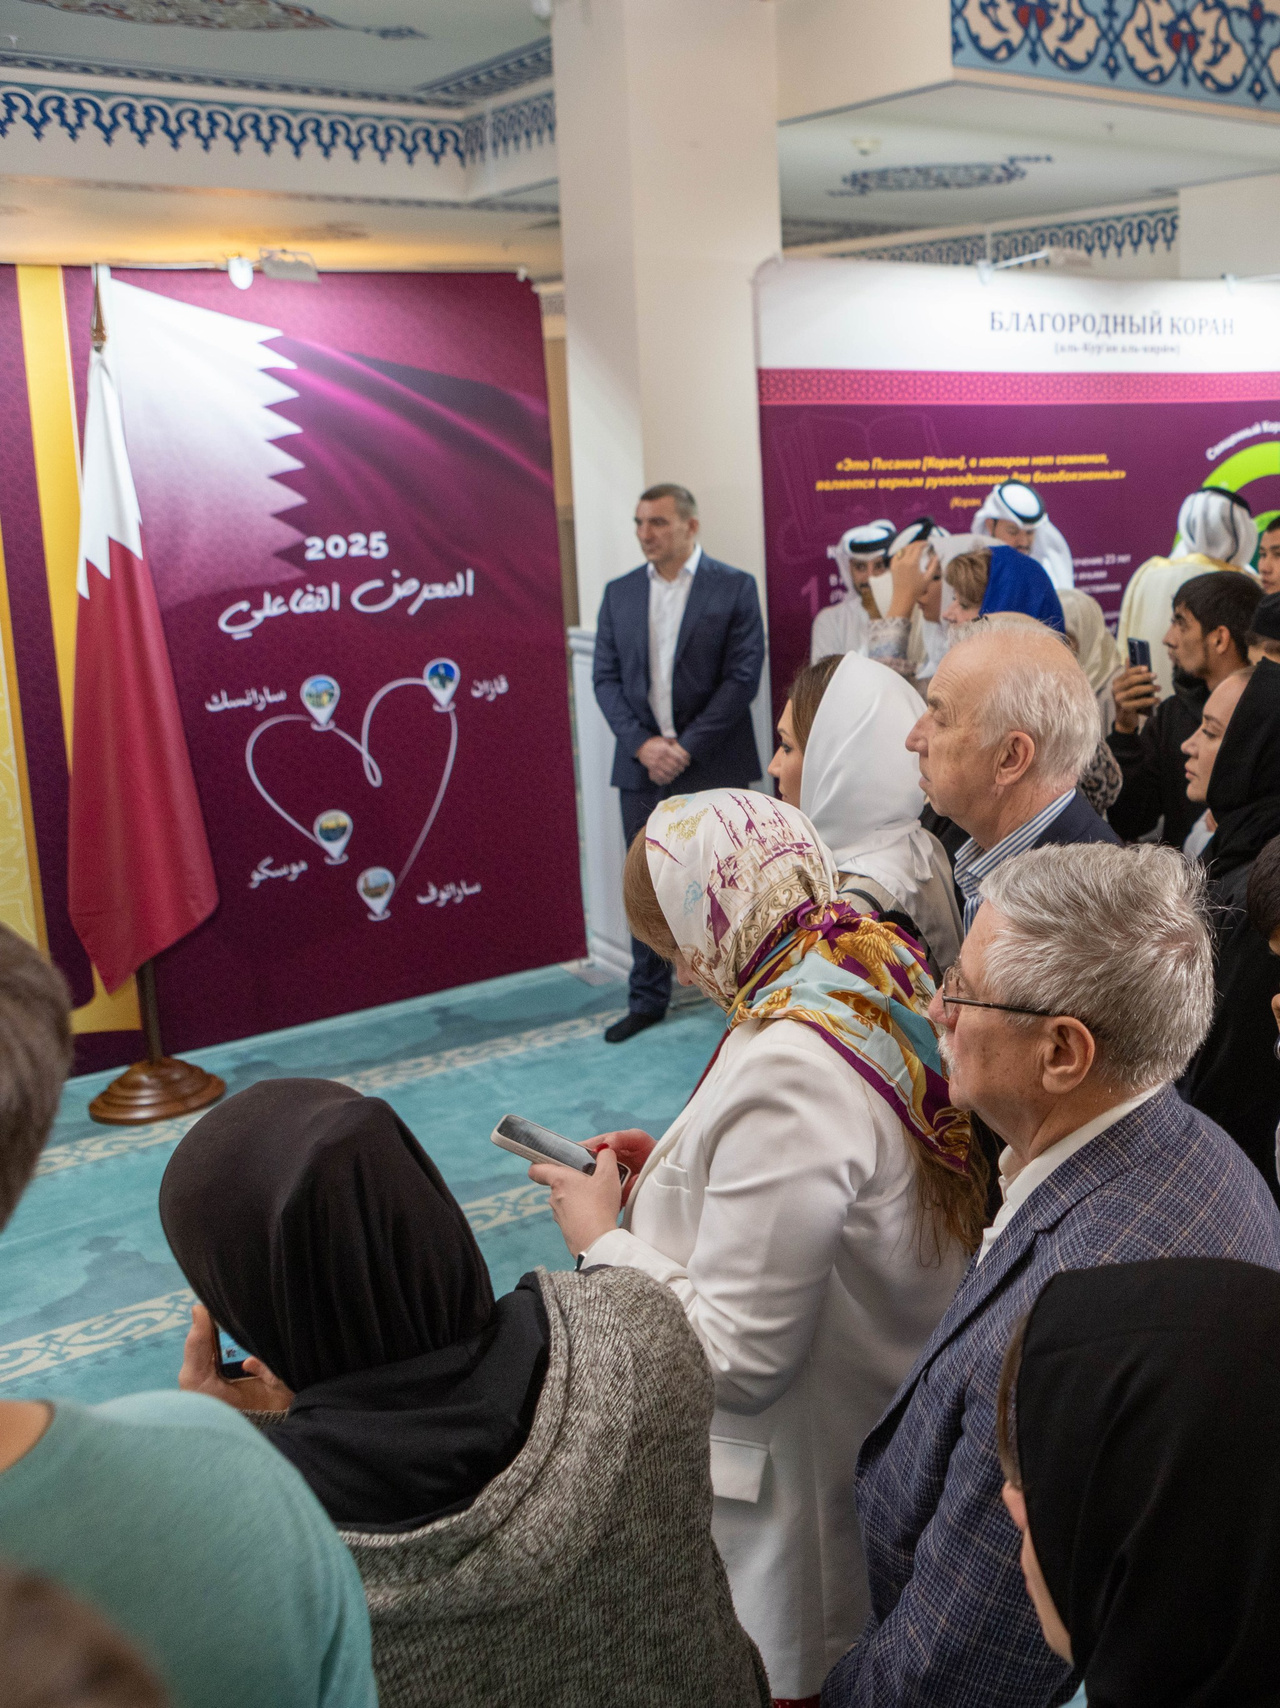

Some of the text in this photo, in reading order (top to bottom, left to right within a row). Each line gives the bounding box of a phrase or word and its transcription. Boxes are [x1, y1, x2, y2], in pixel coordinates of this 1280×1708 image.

[990, 310, 1235, 337] БЛАГОРОДНЫЙ КОРАН
[871, 456, 922, 471] Писание
[978, 456, 1030, 469] котором
[1031, 455, 1054, 466] нет
[877, 476, 925, 491] верным
[925, 472, 1009, 490] руководством
[304, 531, 389, 561] 2025
[217, 568, 475, 640] المعرض التفاعلي
[248, 855, 309, 889] موسكو
